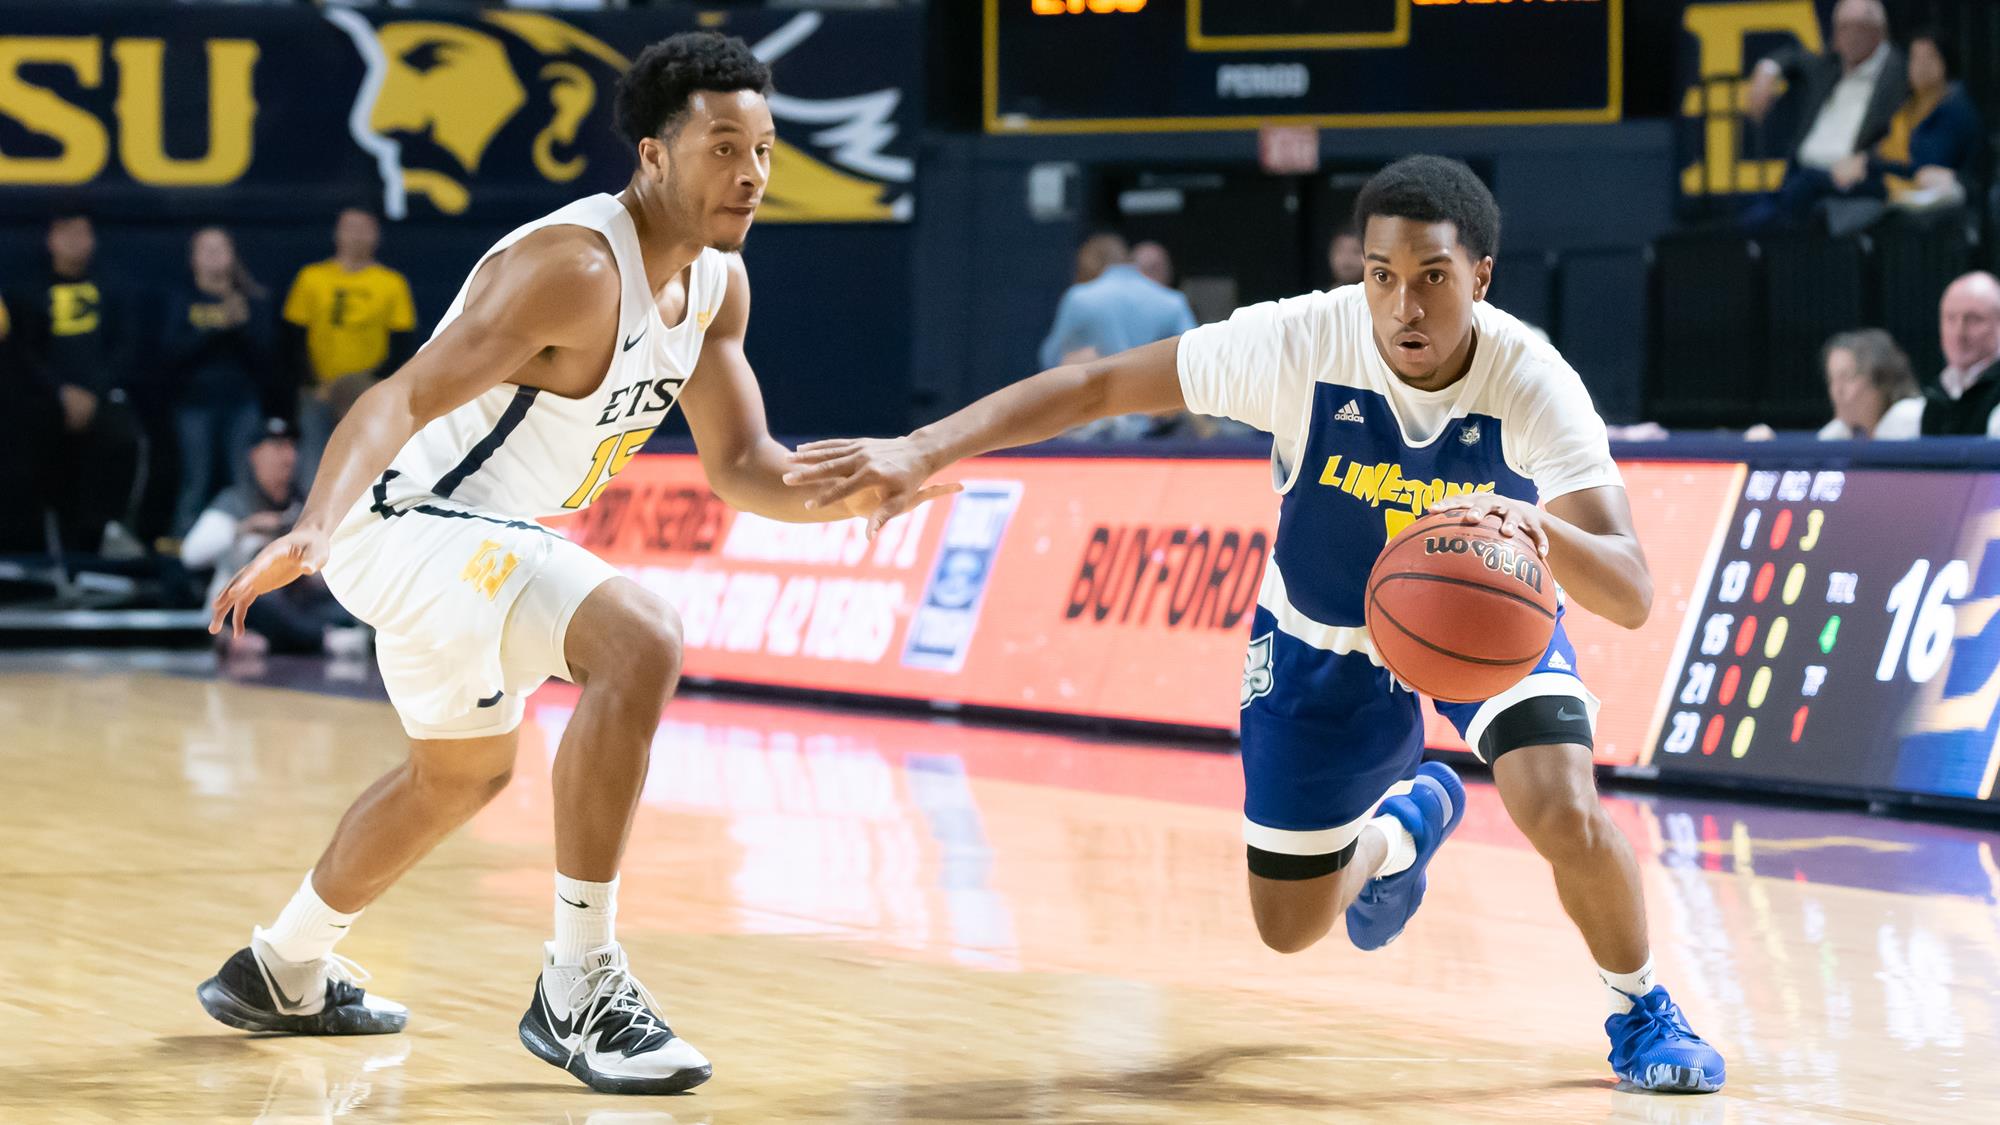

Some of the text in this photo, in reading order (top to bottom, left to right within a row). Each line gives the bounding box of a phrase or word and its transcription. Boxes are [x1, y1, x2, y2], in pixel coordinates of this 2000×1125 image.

[1334, 413, 1364, 424] adidas
[1740, 508, 1761, 550] 1
[1770, 508, 1792, 550] 0
[1064, 526, 1269, 629] BUYFORD
[1425, 536, 1542, 594] Wilson
[1718, 560, 1806, 605] 13 0 0
[1700, 613, 1789, 659] 15 0 0
[1818, 615, 1841, 654] 4
[1875, 558, 1970, 683] 16
[1679, 662, 1773, 709] 21 0 0
[1663, 711, 1756, 759] 23 0 0
[1790, 704, 1810, 743] 1
